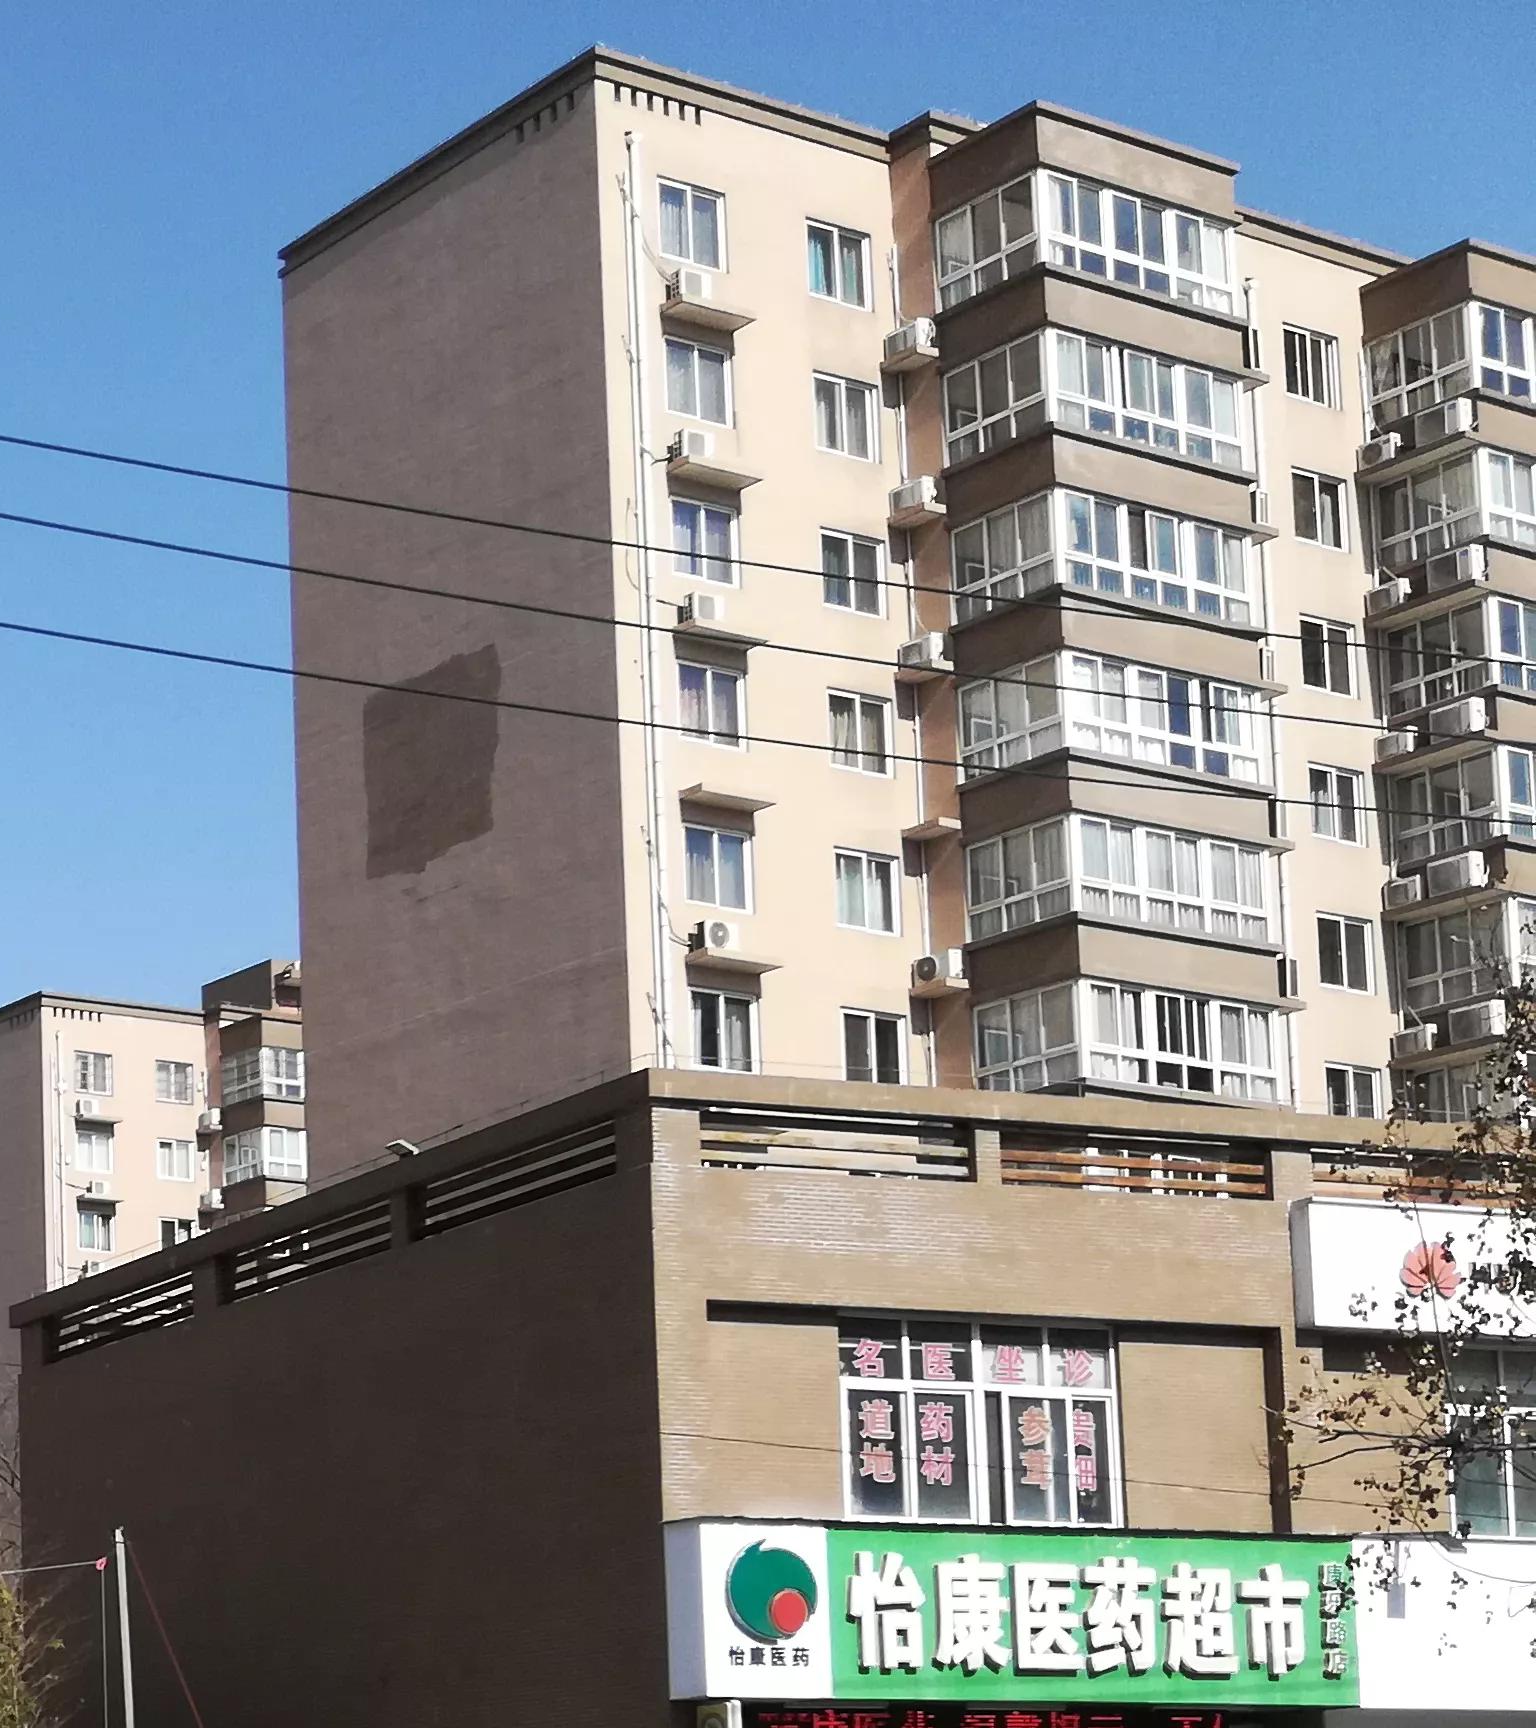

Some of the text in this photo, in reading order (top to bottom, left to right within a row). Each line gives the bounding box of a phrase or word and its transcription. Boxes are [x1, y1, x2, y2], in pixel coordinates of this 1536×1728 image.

[853, 1338, 1095, 1387] 名医坐诊
[858, 1398, 896, 1483] 道地
[918, 1401, 956, 1486] 药材
[727, 1645, 810, 1668] 怡康医药
[846, 1550, 1311, 1678] 怡康医药超市
